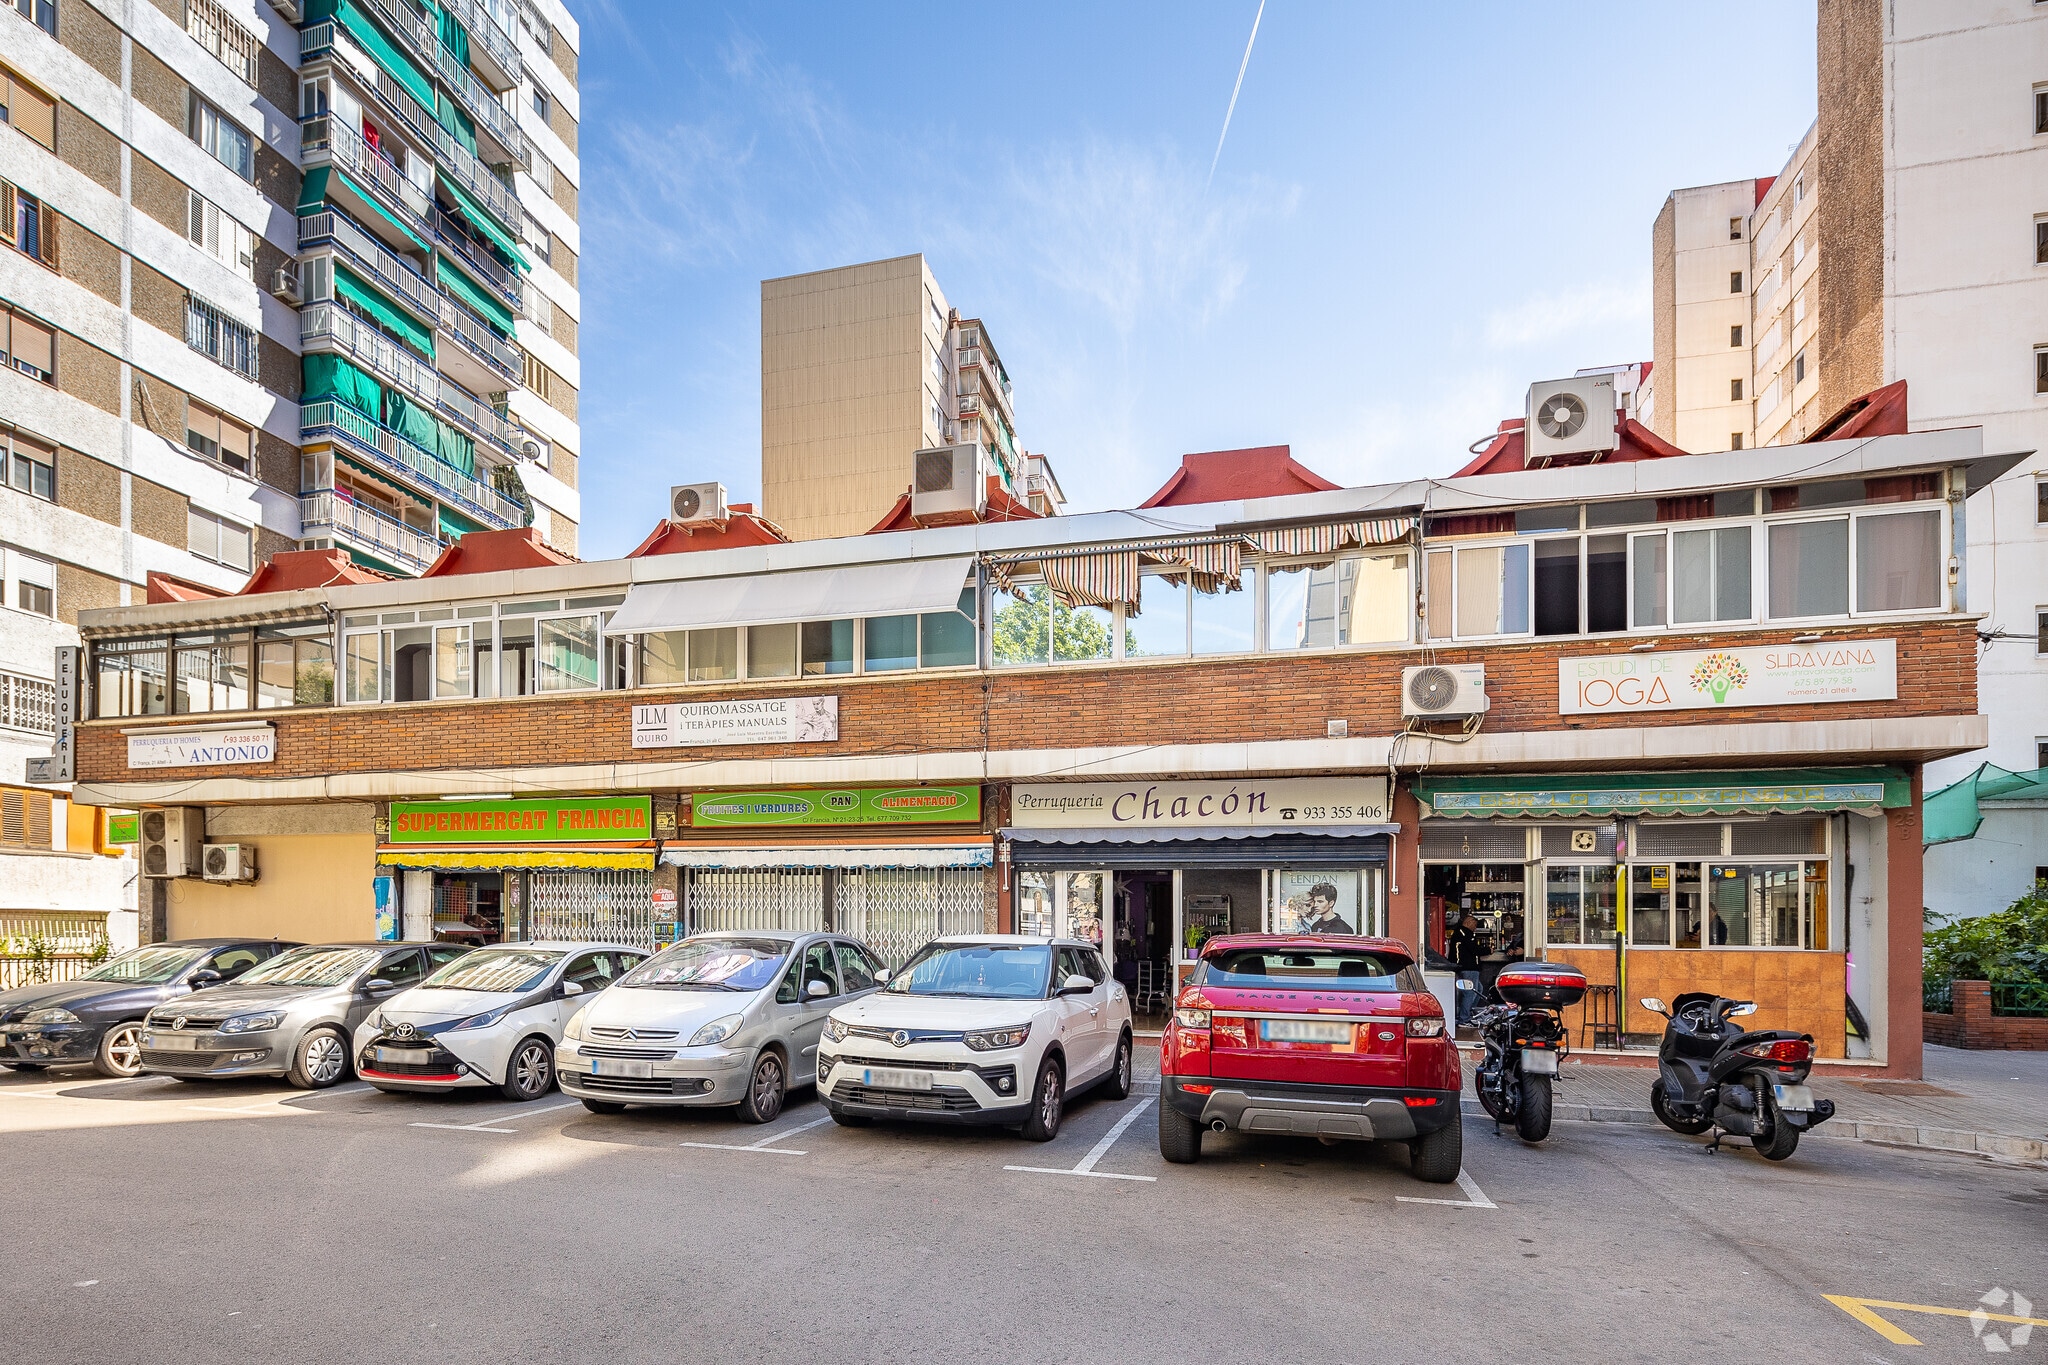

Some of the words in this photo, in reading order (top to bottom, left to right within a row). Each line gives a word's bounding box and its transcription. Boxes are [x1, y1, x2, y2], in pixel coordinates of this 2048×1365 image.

[1577, 660, 1637, 677] ESTUDI
[1650, 657, 1673, 673] DE
[1765, 649, 1876, 670] SHRAVANA
[1794, 678, 1811, 687] 675
[1813, 678, 1825, 686] 89
[1828, 677, 1839, 685] 79
[1841, 676, 1853, 684] 58
[1578, 676, 1672, 708] IOGA
[1787, 687, 1818, 696] número
[1820, 687, 1828, 695] 21
[61, 650, 69, 778] PELUQUERIA
[637, 707, 668, 725] JLM
[680, 701, 787, 718] QUIROMASSATGE
[685, 717, 734, 730] TERÀPIES
[737, 717, 787, 728] MANUALS
[133, 737, 173, 747] PERRUQUERIA
[229, 736, 238, 744] 93
[637, 733, 668, 745] QUIRO
[190, 744, 269, 763] ANTONIO
[831, 796, 851, 806] PAN
[882, 793, 957, 808] ALIMENTACIÓ
[1018, 793, 1104, 813] Perruqueria
[1111, 786, 1270, 822] Chacón
[1479, 793, 1535, 807] BAR
[1551, 792, 1588, 806] LA
[701, 804, 744, 815] FRUITES
[754, 802, 808, 814] VERDURES
[1303, 806, 1326, 819] 933
[1330, 806, 1353, 819] 355
[1356, 805, 1382, 818] 406
[397, 810, 548, 832] SUPERMERCAT
[557, 808, 646, 829] FRANCIA
[1236, 992, 1297, 1000] RANGE
[1313, 994, 1376, 1004] ROVER
